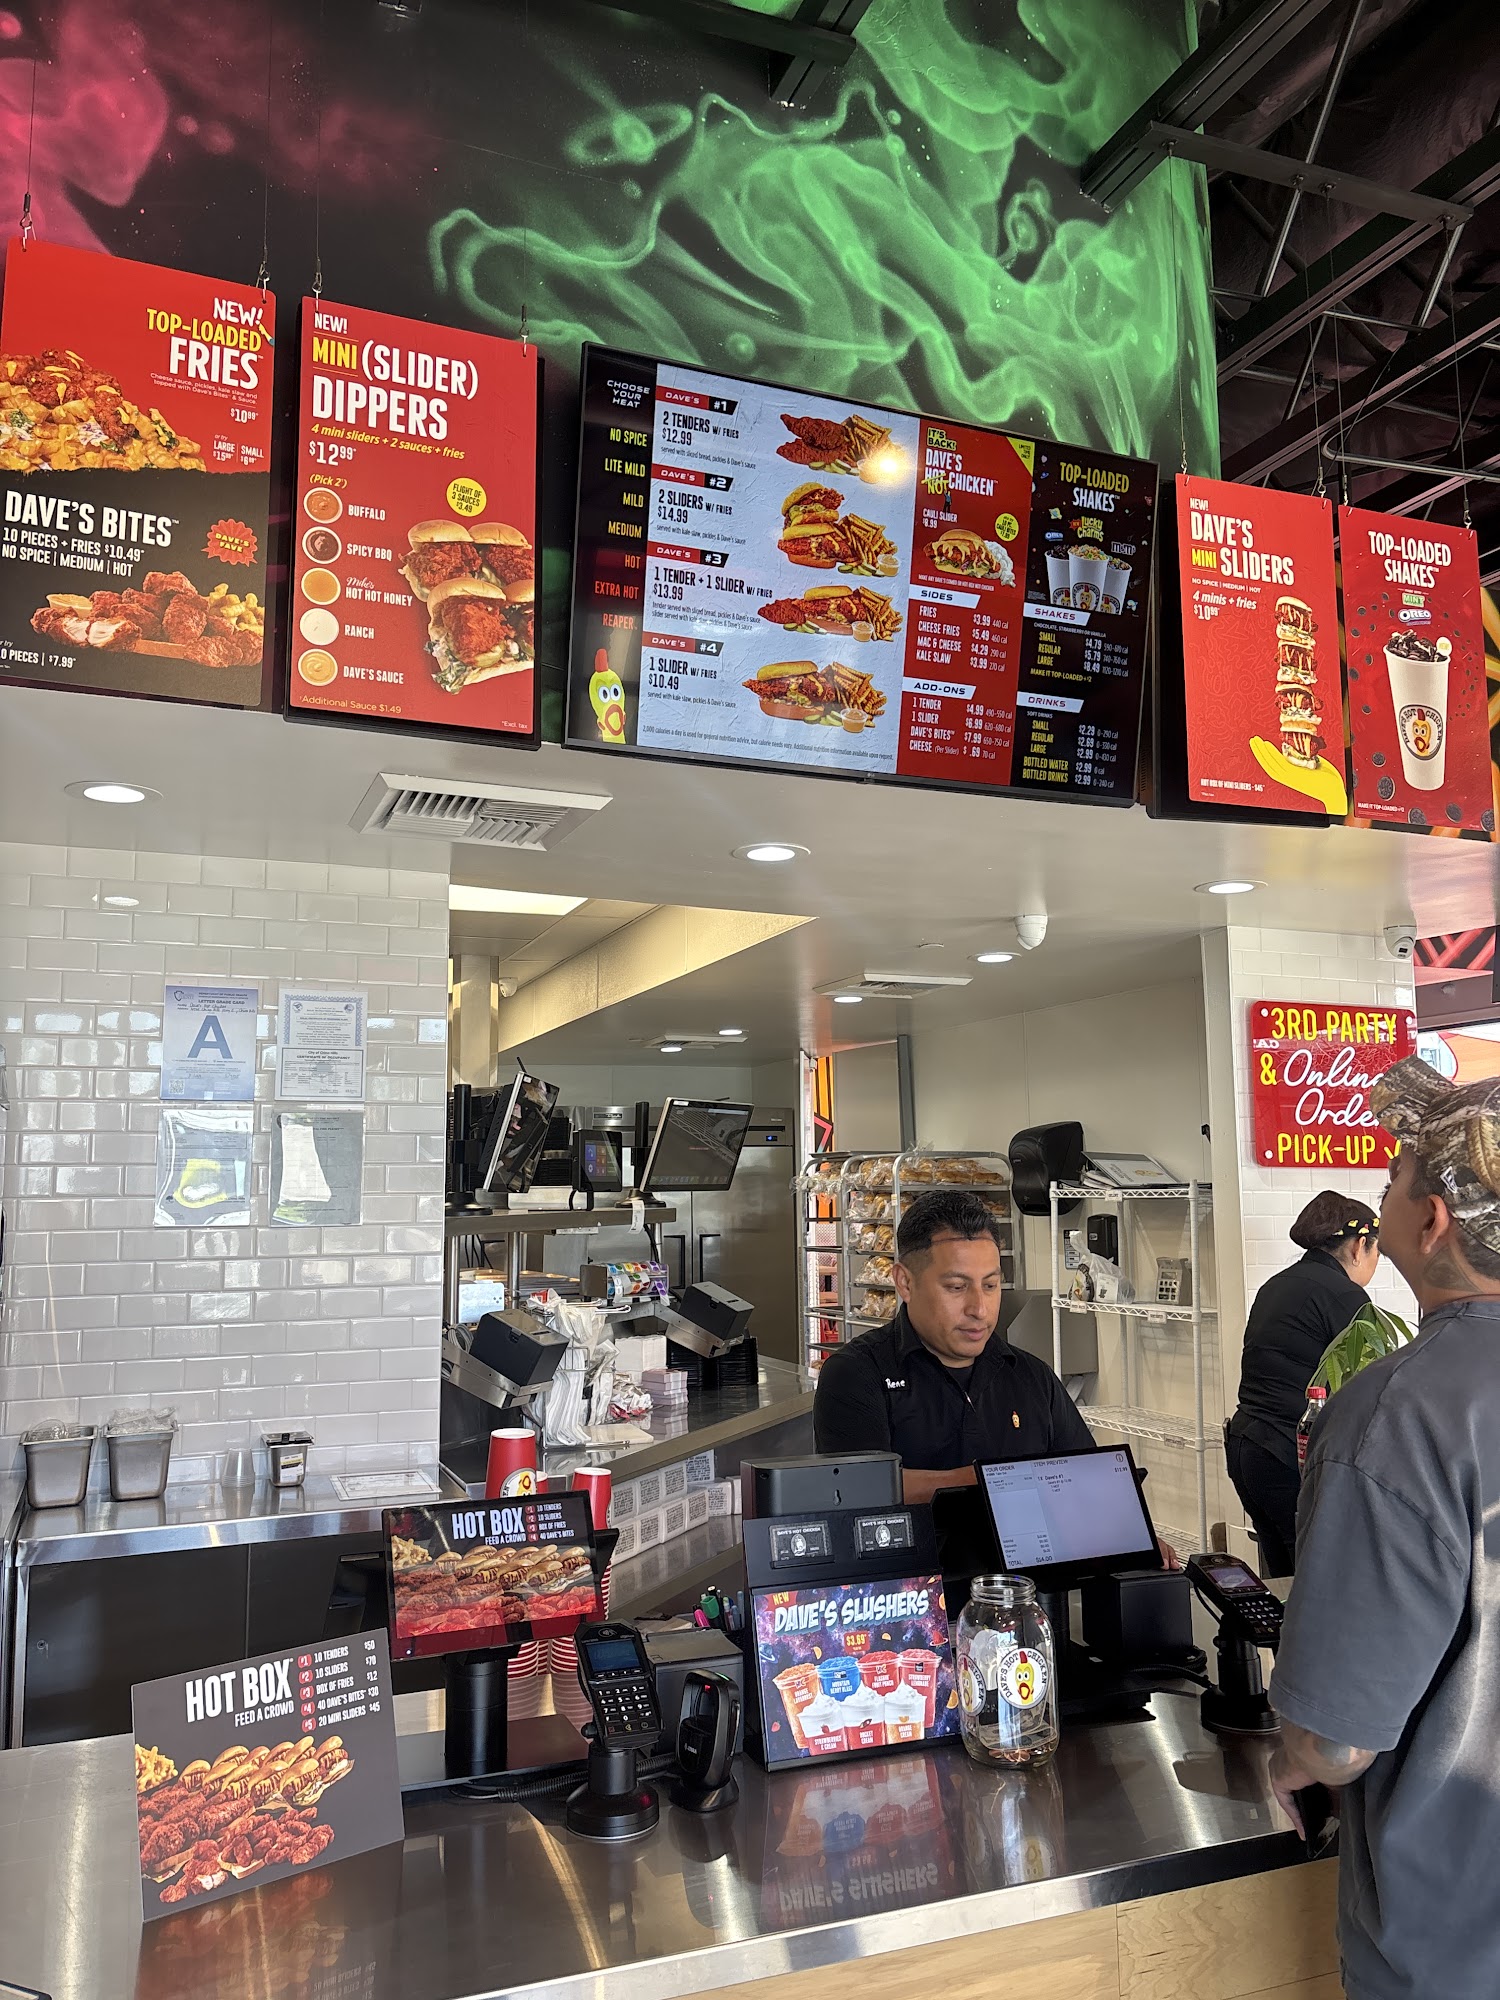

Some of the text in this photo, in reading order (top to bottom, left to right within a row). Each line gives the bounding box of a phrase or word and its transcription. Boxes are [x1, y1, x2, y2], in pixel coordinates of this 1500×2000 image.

[213, 297, 264, 327] NEW!
[146, 308, 261, 352] TOP-LOADED
[314, 312, 348, 335] NEW!
[312, 336, 479, 400] MINI (SLIDER)
[607, 380, 650, 394] CHOOSE
[613, 389, 641, 401] YOUR
[312, 375, 448, 441] DIPPERS
[612, 397, 640, 408] HEAT
[665, 392, 727, 411] DAVE'S #1
[663, 411, 739, 439] 2 TENDERS W/ FRIES
[928, 428, 945, 439] IT'S
[610, 428, 647, 447] NO SPICE
[662, 428, 692, 446] $12.99
[927, 437, 956, 450] BACK!
[213, 440, 264, 459] LARGE SMALL
[605, 458, 646, 478] LITE MILD
[926, 449, 963, 471] DAVE'S
[1060, 462, 1129, 493] TOP-LOADED
[453, 483, 482, 498] FLIGHT OF
[457, 492, 480, 508] SAUCES
[623, 492, 644, 508] MILD
[5, 489, 95, 536] DAVE'S
[348, 505, 385, 521] BUFFALO
[456, 501, 473, 513] $3.49
[1190, 497, 1209, 511] NEW!
[923, 508, 958, 522] CAULI SLIDER
[608, 521, 642, 538] MEDIUM
[1190, 511, 1254, 548] DAVE'S
[215, 533, 250, 547] DAVE'S
[219, 542, 244, 553] FAVE
[1368, 530, 1452, 567] TOP-LOADED
[1, 543, 134, 577] NO SPICE MEDIUM HOT
[347, 543, 392, 561] SPICY BBQ
[625, 554, 640, 569] HOT
[1192, 547, 1294, 586] MINI SLIDERS
[346, 576, 375, 590] Mike's
[595, 581, 639, 599] EXTRA HOT
[653, 584, 683, 600] $13.99
[1202, 579, 1218, 587] SPICE
[1222, 581, 1245, 591] MEDIUM
[1249, 585, 1261, 593] HOT
[346, 587, 413, 607] HOT HOT HONEY
[921, 590, 953, 601] SIDES
[919, 605, 990, 627] FRIES $3.99
[1034, 608, 1076, 620] SHAKES
[1398, 609, 1432, 622] OREO
[345, 625, 375, 639] RANCH
[1039, 631, 1102, 650] SMALL $4.79
[649, 657, 716, 679] 1 SLIDER W/ FRIES
[916, 650, 988, 669] KALE SLAW $3.99
[343, 666, 404, 685] DAVE'S SAUCE
[649, 673, 679, 690] $10.49
[914, 682, 965, 695] ADD-ONS
[913, 697, 984, 716] 1 TENDER $4.99
[1028, 697, 1066, 708] DRINKS
[1023, 756, 1092, 773] BOTTLED WATER $2.99
[1271, 1008, 1397, 1044] 3RD PARTY
[187, 1015, 233, 1059] A
[1260, 1053, 1277, 1086] &
[1277, 1133, 1376, 1165] PICK-UP
[885, 1378, 906, 1390] Rene
[452, 1507, 525, 1540] HOT BOX
[485, 1533, 526, 1545] FEED A CROWD
[773, 1592, 789, 1604] NEW
[774, 1600, 837, 1635] DAVE'S
[300, 1640, 375, 1666] #1 10 TENDERS $50
[300, 1655, 377, 1682] #2 10 SLIDERS $70
[1000, 1651, 1047, 1698] DAVE'S HOT CHICKEN
[186, 1671, 237, 1722] HOT
[234, 1700, 294, 1728] FEED A CROWD
[303, 1702, 380, 1730] #5 20 MINI SLIDERS $45
